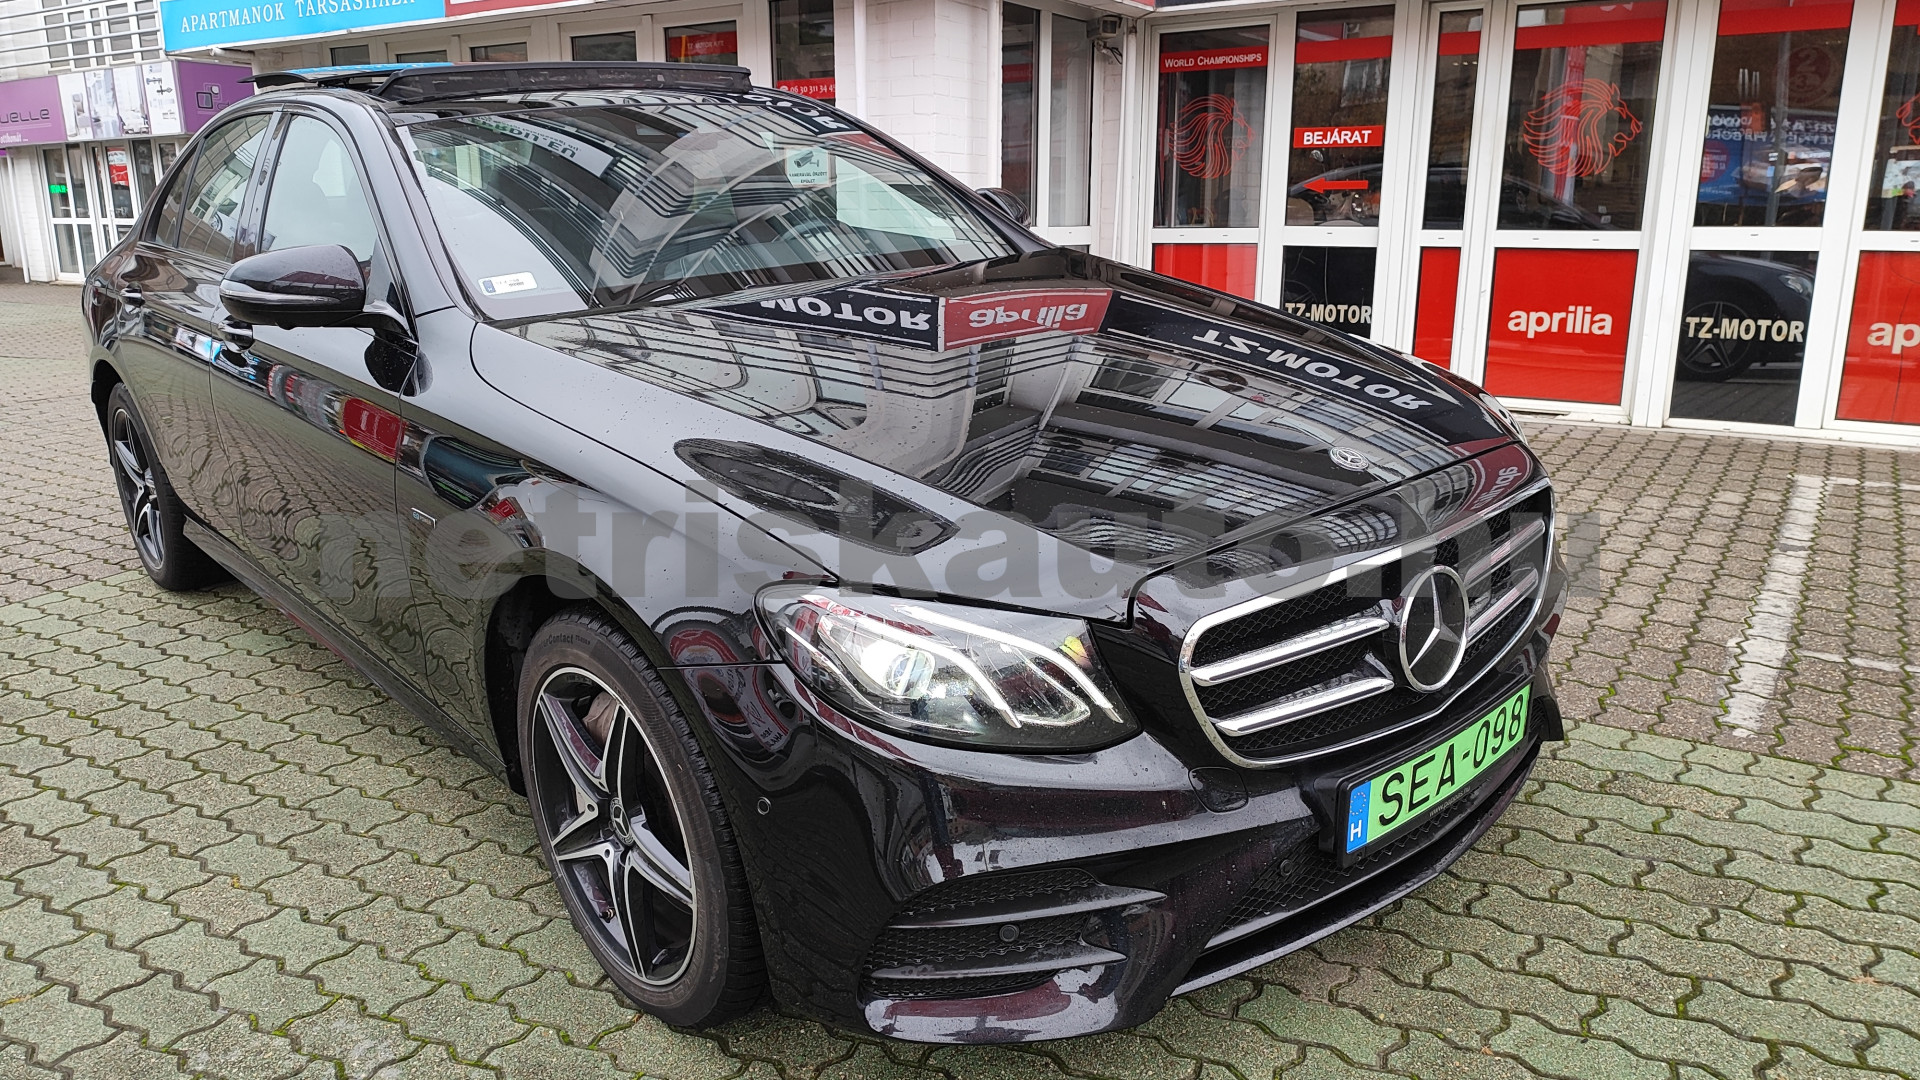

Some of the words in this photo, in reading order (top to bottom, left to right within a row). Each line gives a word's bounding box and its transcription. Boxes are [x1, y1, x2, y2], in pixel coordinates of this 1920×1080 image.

[181, 3, 285, 33] APARTMANOK
[1164, 58, 1194, 68] WORLD
[1197, 53, 1262, 66] CHAMPIONSHIPS
[800, 85, 808, 94] 30
[819, 84, 827, 94] 34
[1303, 130, 1372, 145] BEJÁRAT
[1285, 303, 1372, 324] TZ-MOTOR
[1507, 305, 1613, 339] aprilia
[1685, 316, 1805, 343] TZ-MOTOR
[1378, 693, 1524, 827] SEA-098
[1350, 818, 1362, 842] H
